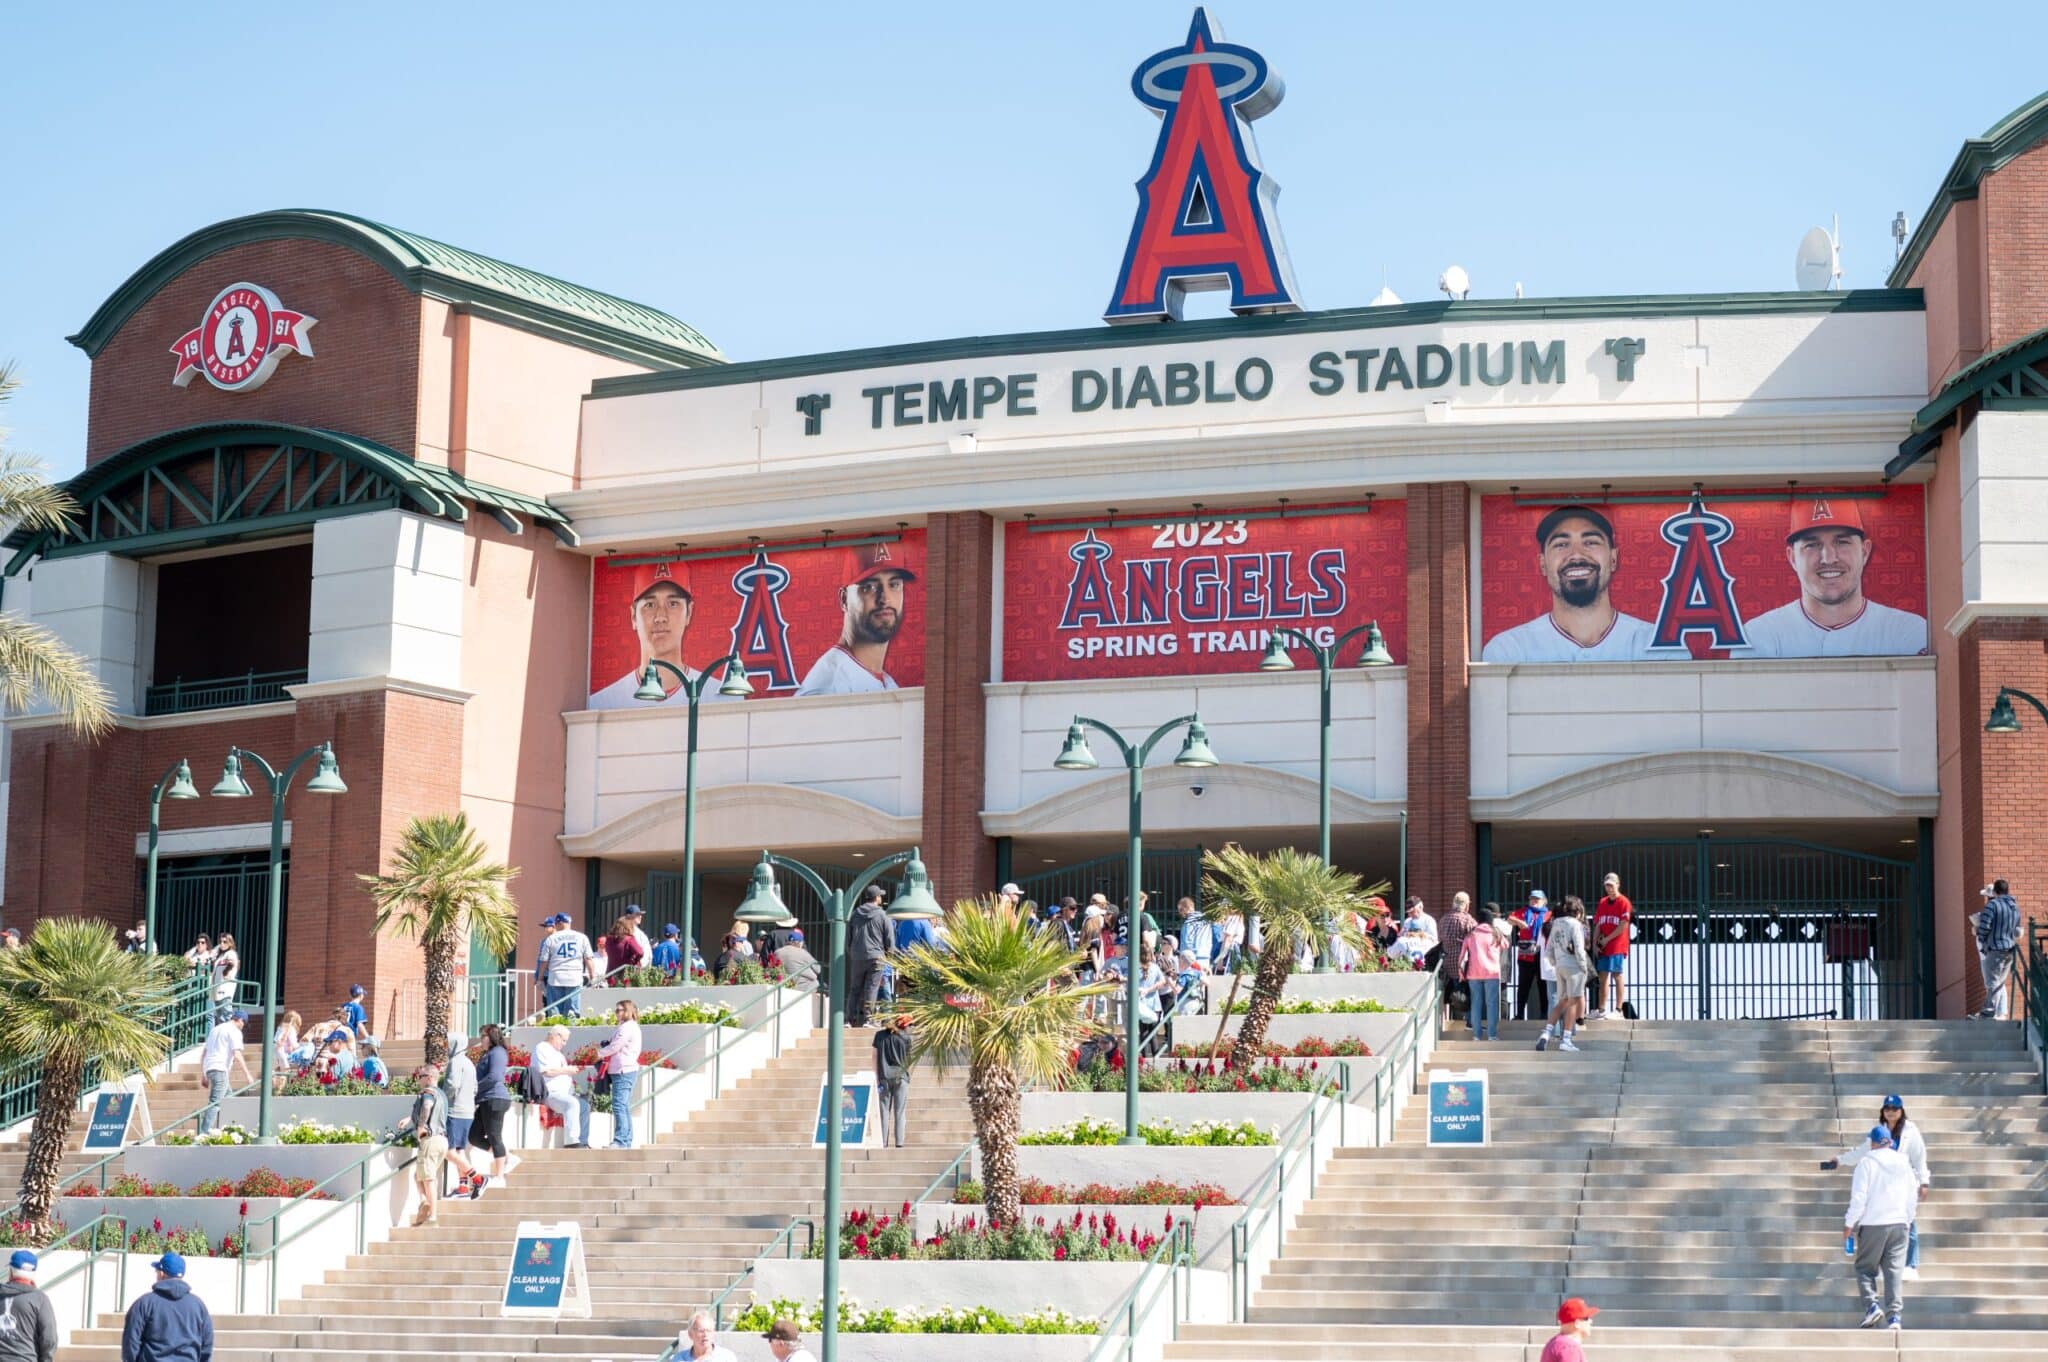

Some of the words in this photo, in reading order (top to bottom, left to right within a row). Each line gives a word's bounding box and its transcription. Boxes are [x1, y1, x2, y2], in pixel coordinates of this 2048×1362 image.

[214, 293, 260, 320] ANGELS
[275, 320, 290, 336] 61
[184, 340, 199, 359] 19
[207, 345, 265, 381] BASEBALL
[862, 373, 1038, 429] TEMPE
[1072, 357, 1274, 413] DIABLO
[1309, 340, 1566, 396] STADIUM
[1152, 520, 1248, 549] 2023
[1058, 528, 1347, 630] ANGELS
[1646, 492, 1753, 651] A
[1067, 632, 1178, 660] SPRING
[1188, 626, 1336, 654] TRAINING
[556, 942, 577, 959] 45
[1432, 1115, 1458, 1123] CLEAR
[1459, 1114, 1480, 1122] BAGS
[512, 1276, 538, 1284] CLEAR
[538, 1276, 561, 1285] BAGS
[524, 1285, 546, 1293] ONLY
